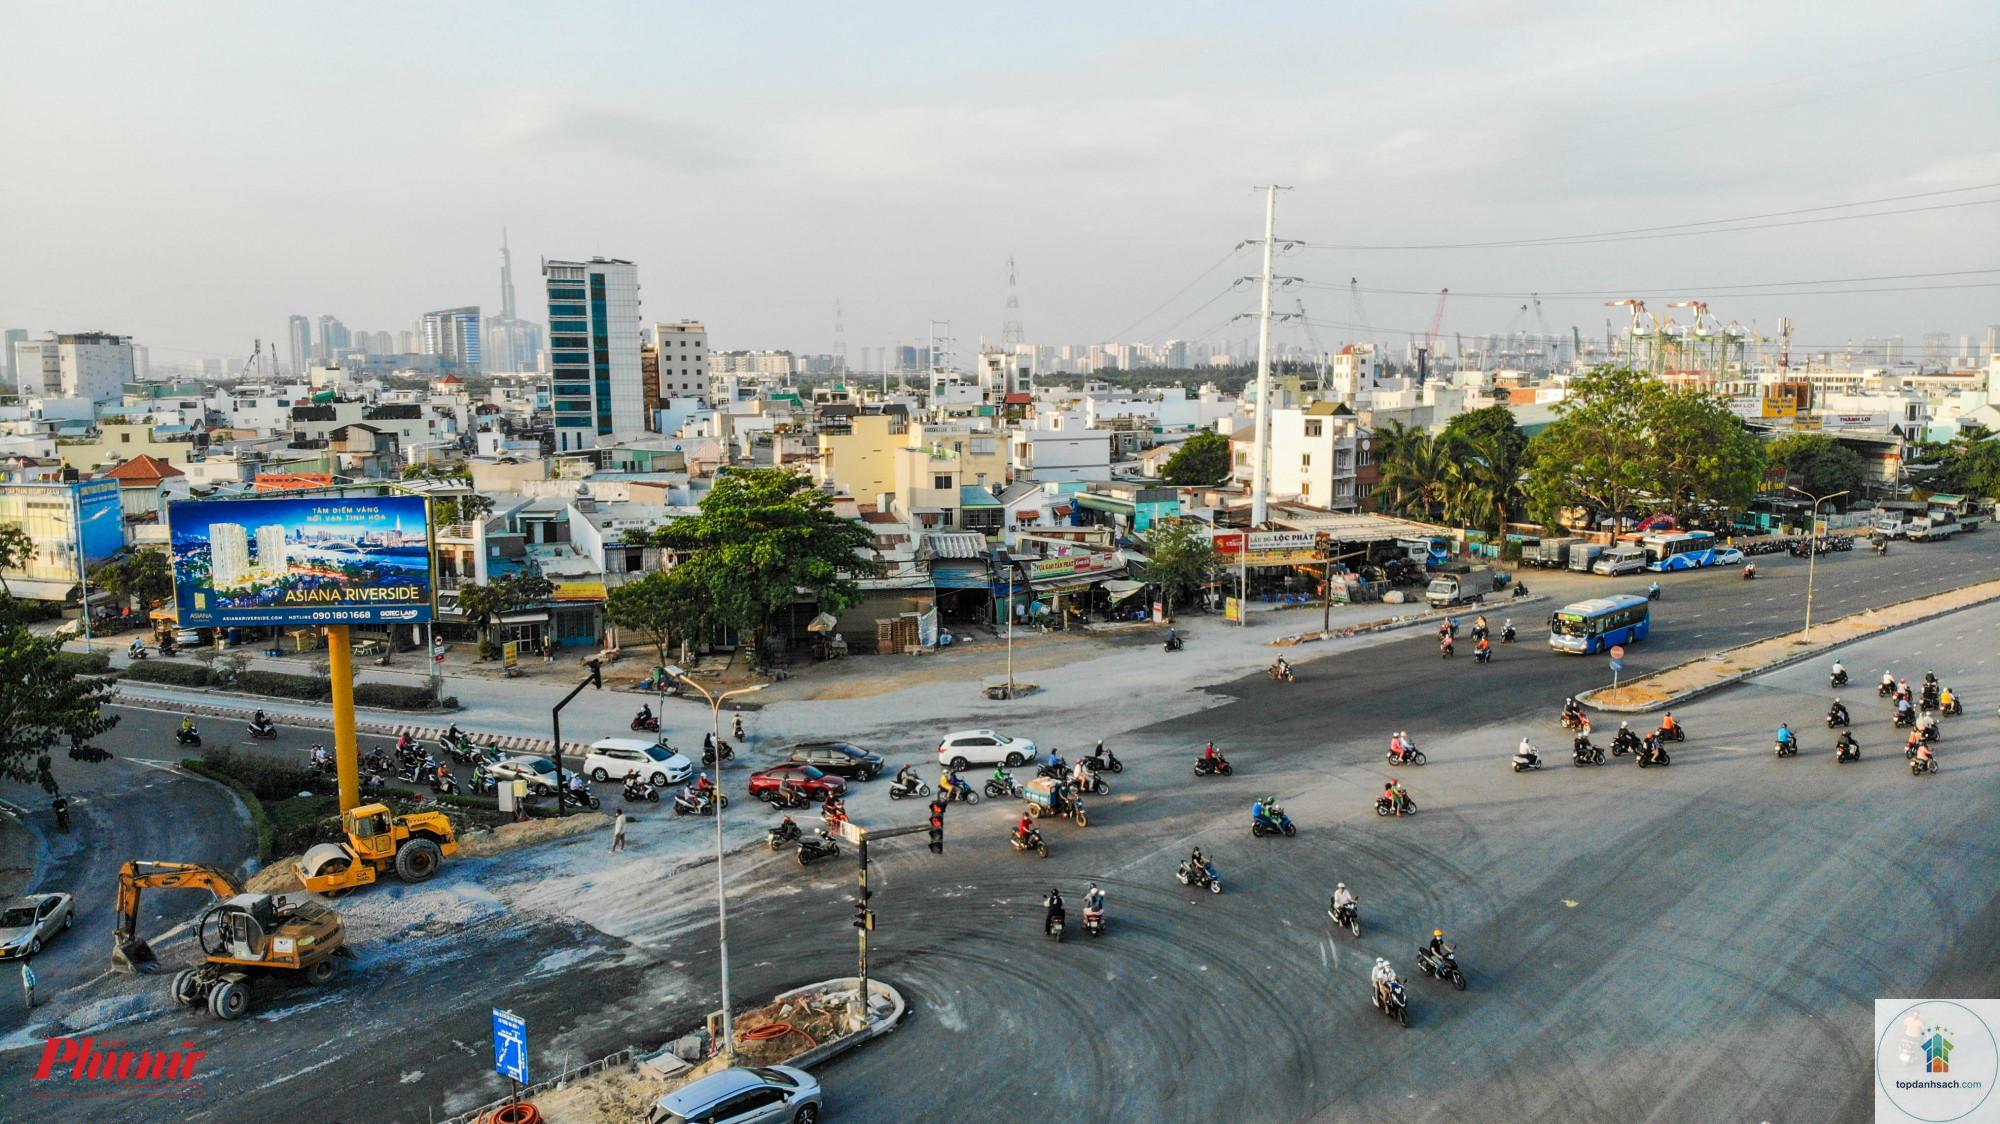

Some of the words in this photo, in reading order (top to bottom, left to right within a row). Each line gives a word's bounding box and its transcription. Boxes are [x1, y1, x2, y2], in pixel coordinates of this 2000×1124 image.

[1274, 533, 1290, 542] LỘC
[1292, 533, 1314, 541] PHÁT
[285, 589, 342, 602] ASIANA
[346, 586, 420, 600] RIVERSIDE
[312, 611, 331, 620] 090
[332, 611, 349, 619] 180
[350, 610, 371, 619] 1668
